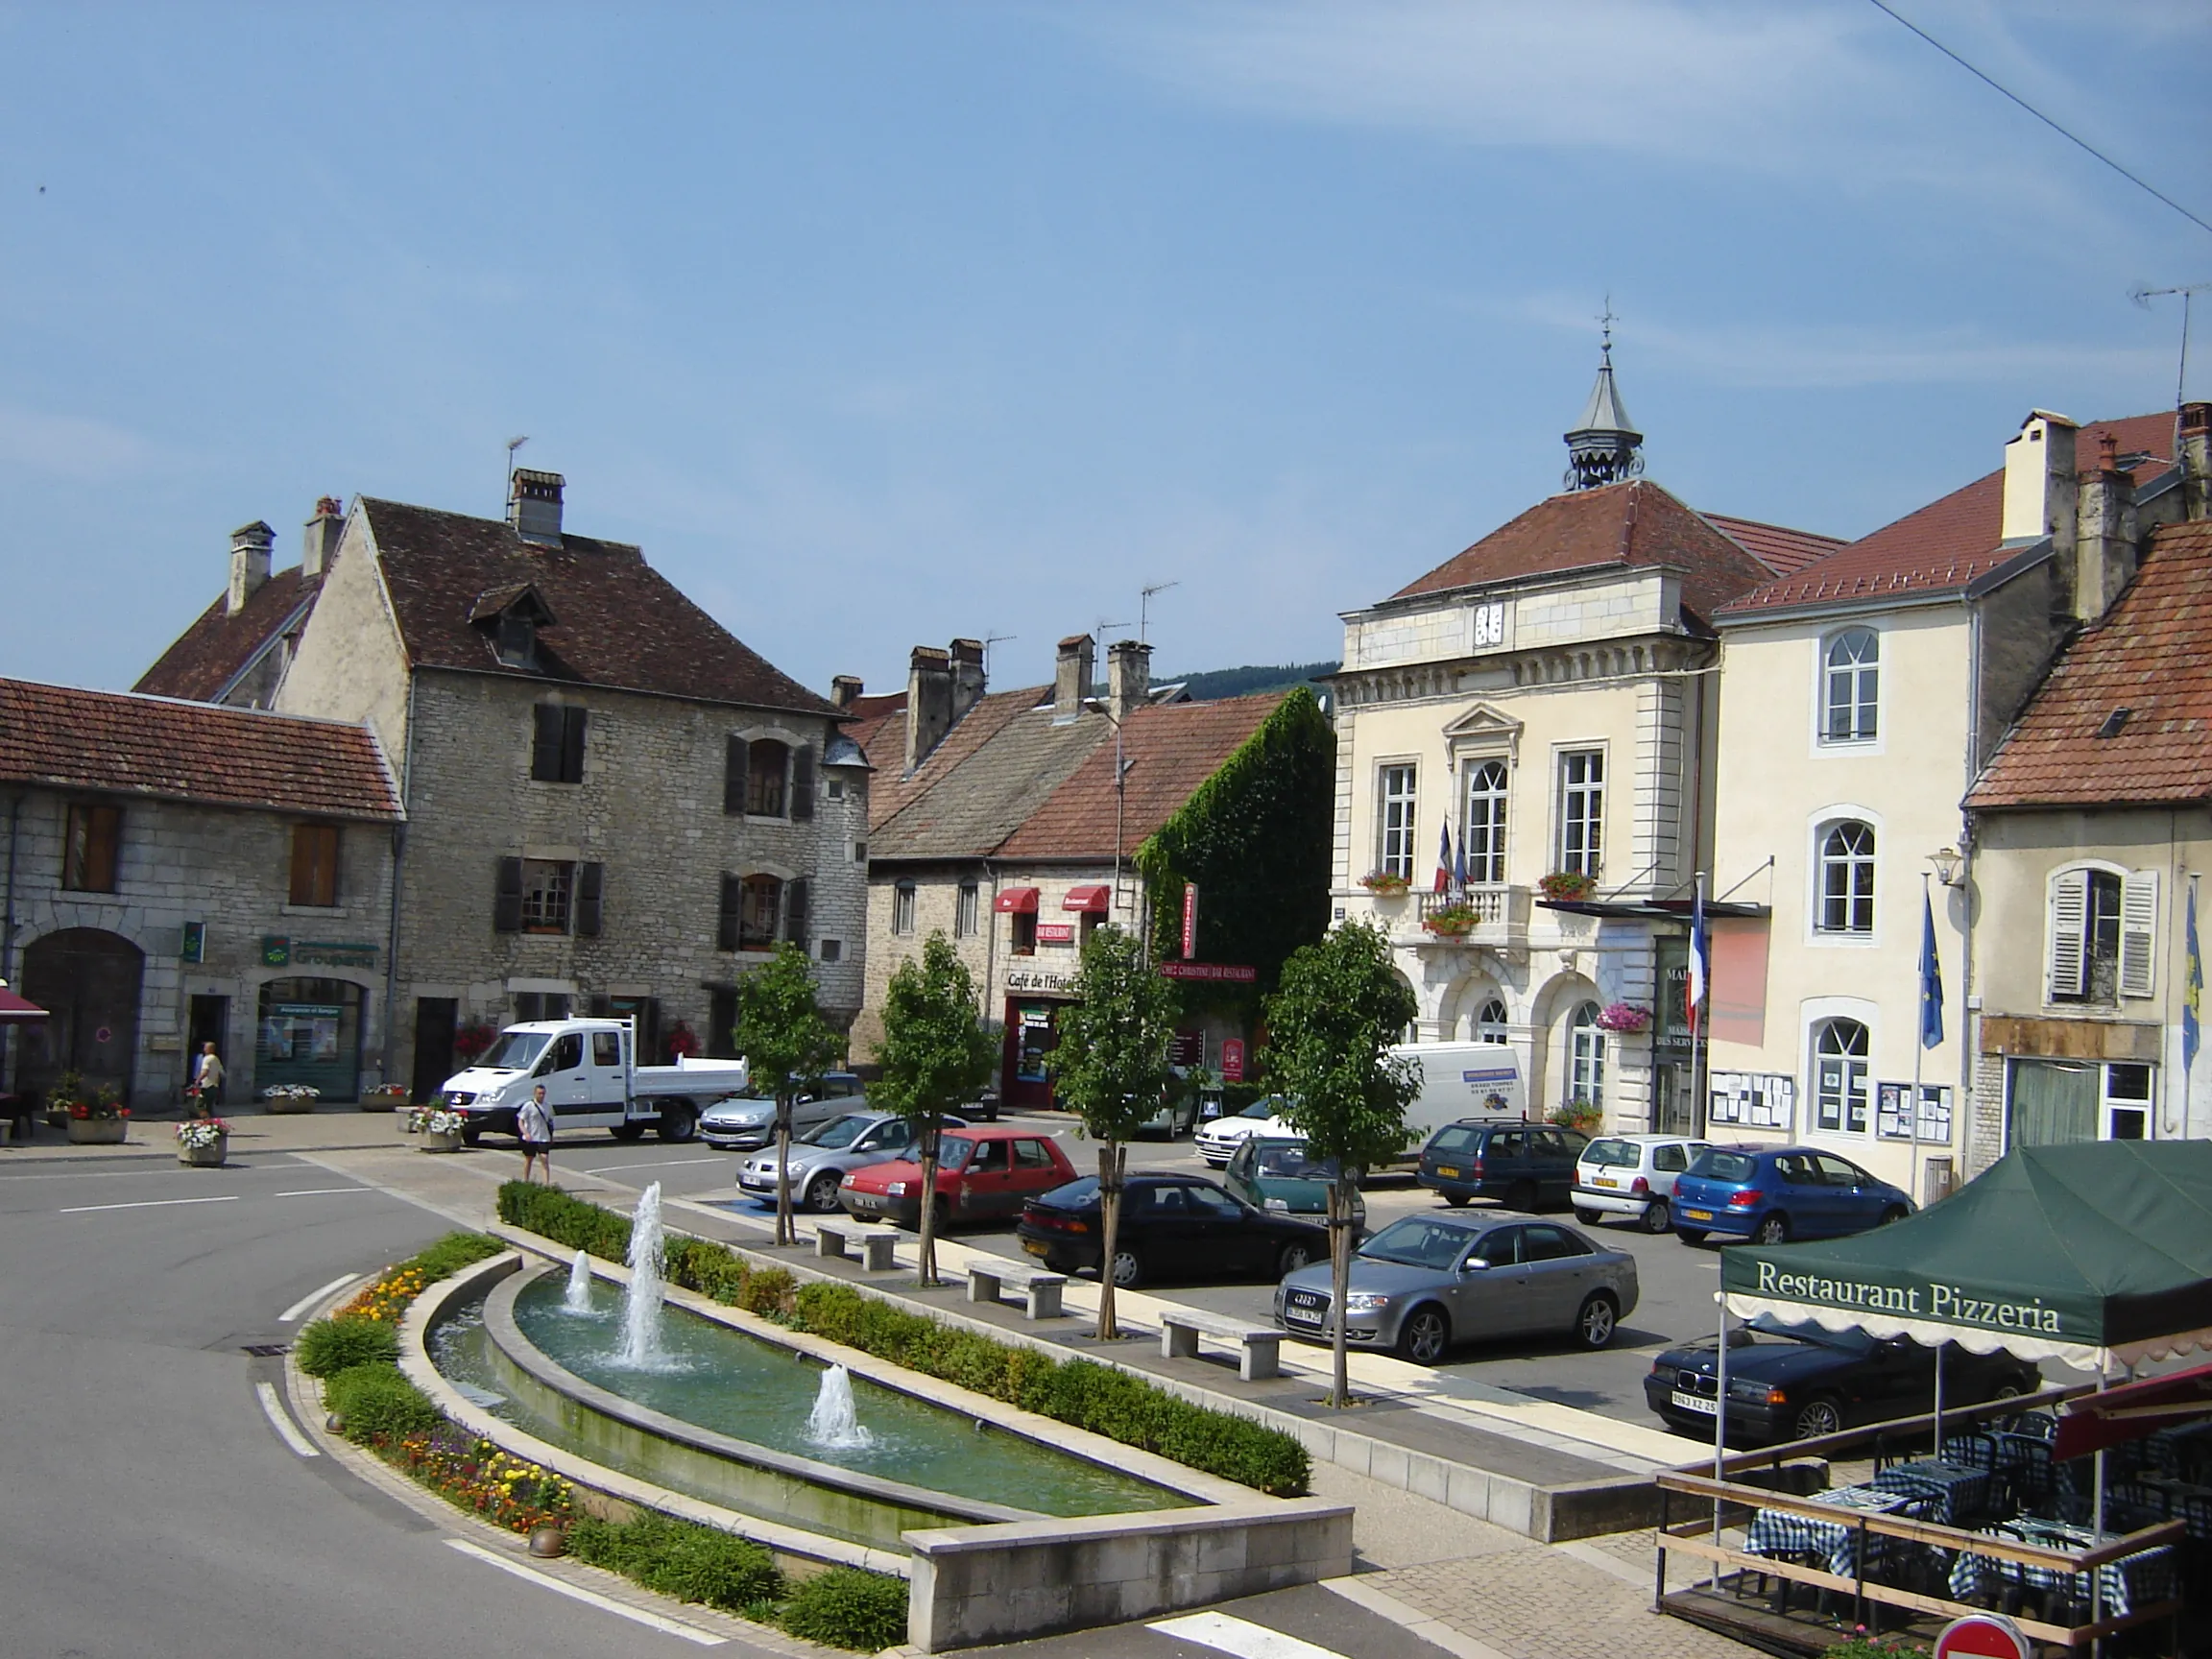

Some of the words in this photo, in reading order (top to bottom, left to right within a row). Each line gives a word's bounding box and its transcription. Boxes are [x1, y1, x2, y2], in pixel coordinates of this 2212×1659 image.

[1046, 926, 1070, 938] RESTAURANT
[1162, 965, 1177, 974] CHEZ
[1178, 966, 1209, 976] CHRISTINE
[1212, 967, 1222, 977] BAR
[1223, 968, 1256, 979] RESTAURANT
[1008, 973, 1029, 990] Café
[1031, 974, 1043, 988] de
[1656, 1037, 1671, 1046] DES
[1757, 1261, 1920, 1313] Restaurant
[1929, 1284, 2060, 1334] Pizzeria
[1705, 1401, 1716, 1412] 25
